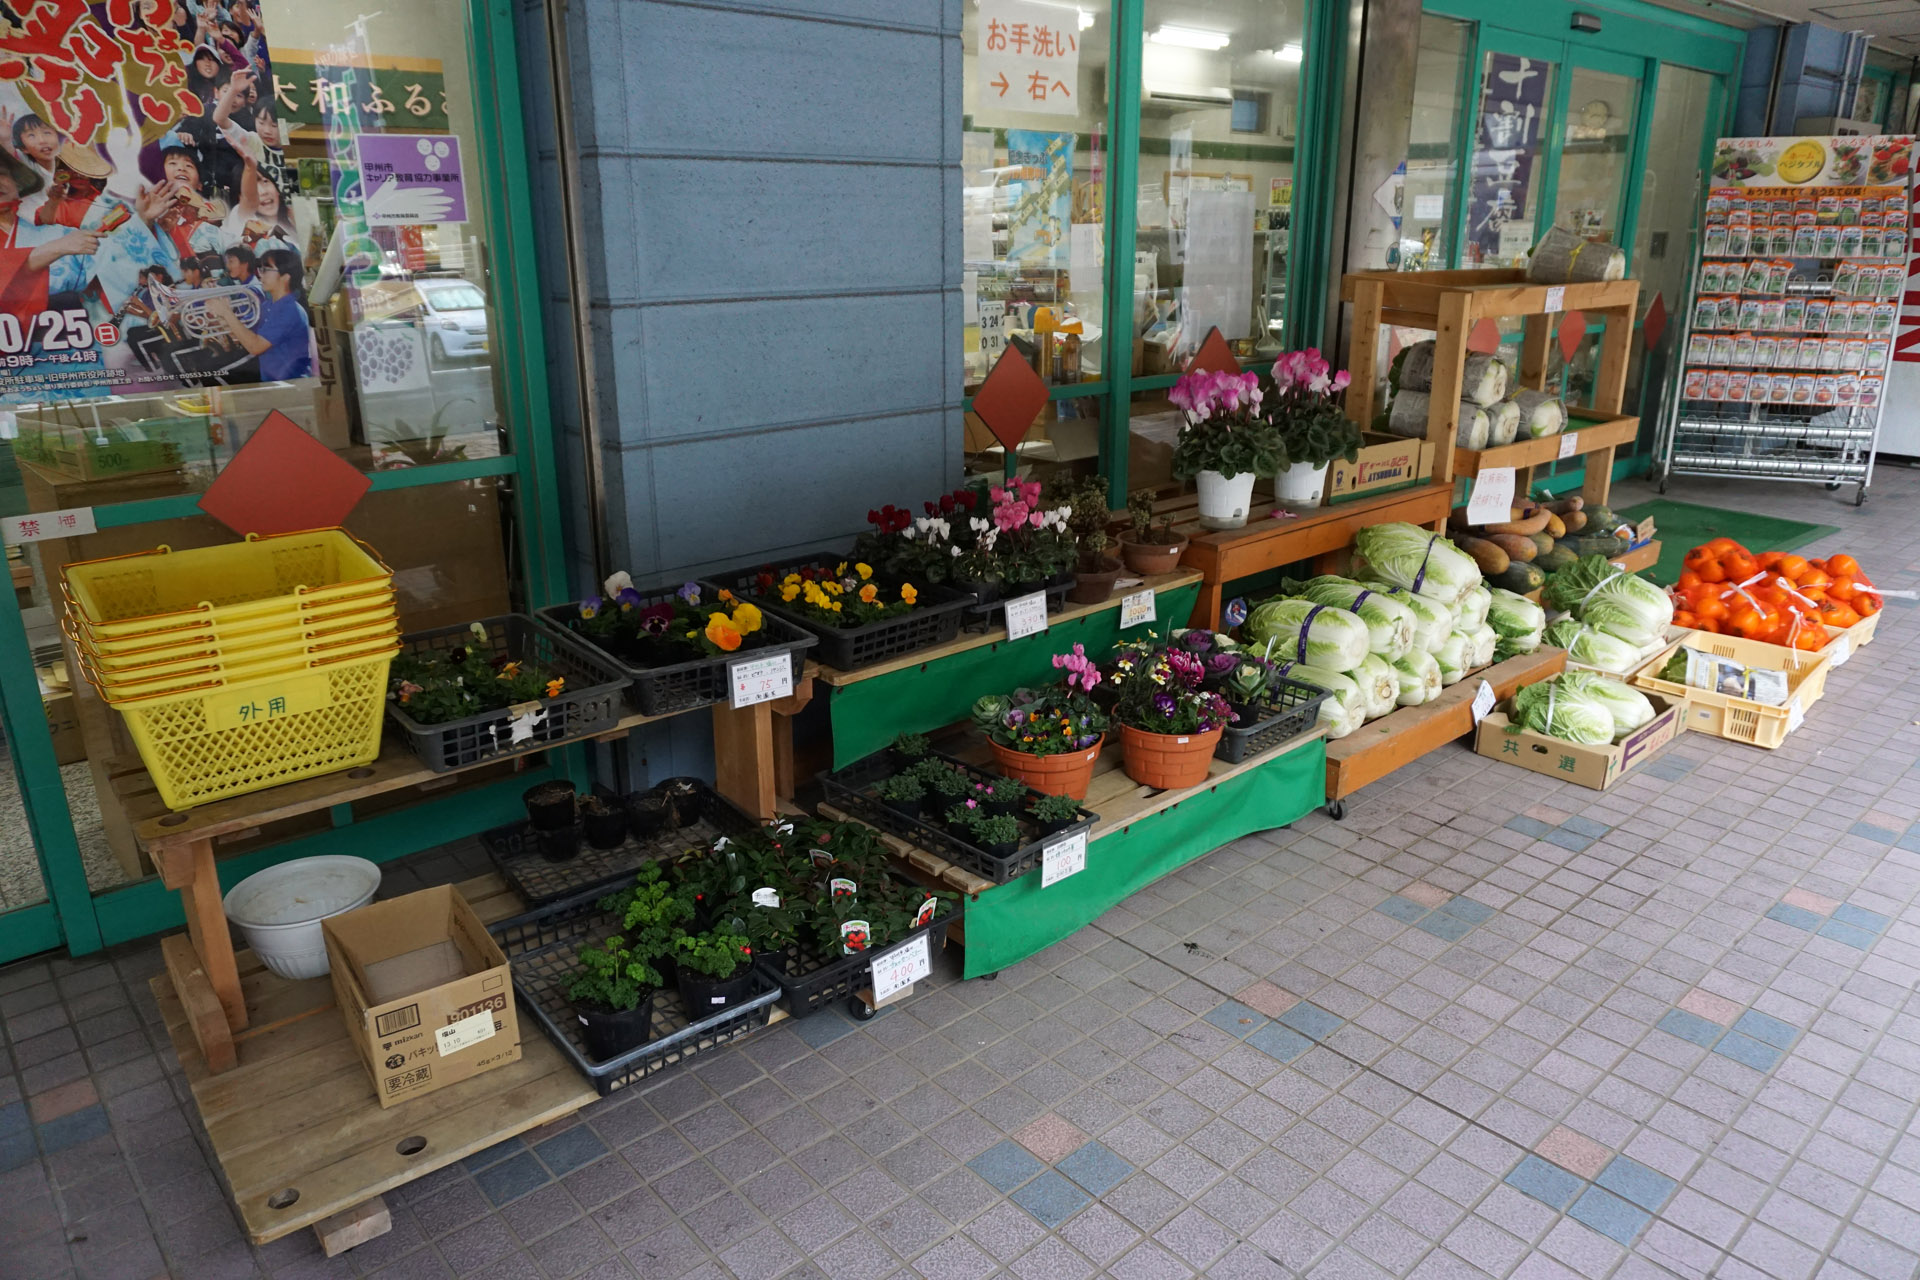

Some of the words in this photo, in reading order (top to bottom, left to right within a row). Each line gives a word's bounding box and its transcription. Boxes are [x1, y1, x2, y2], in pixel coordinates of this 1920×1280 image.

[987, 18, 1076, 57] お手洗い
[1028, 70, 1071, 100] 右へ
[364, 163, 393, 172] 甲州市
[990, 336, 998, 347] 31
[760, 679, 773, 691] 75
[239, 697, 285, 721] 外用
[1057, 855, 1072, 870] 100
[890, 962, 914, 982] 400
[395, 1032, 423, 1046] mizkan
[388, 1068, 430, 1092] 要冷蔵
